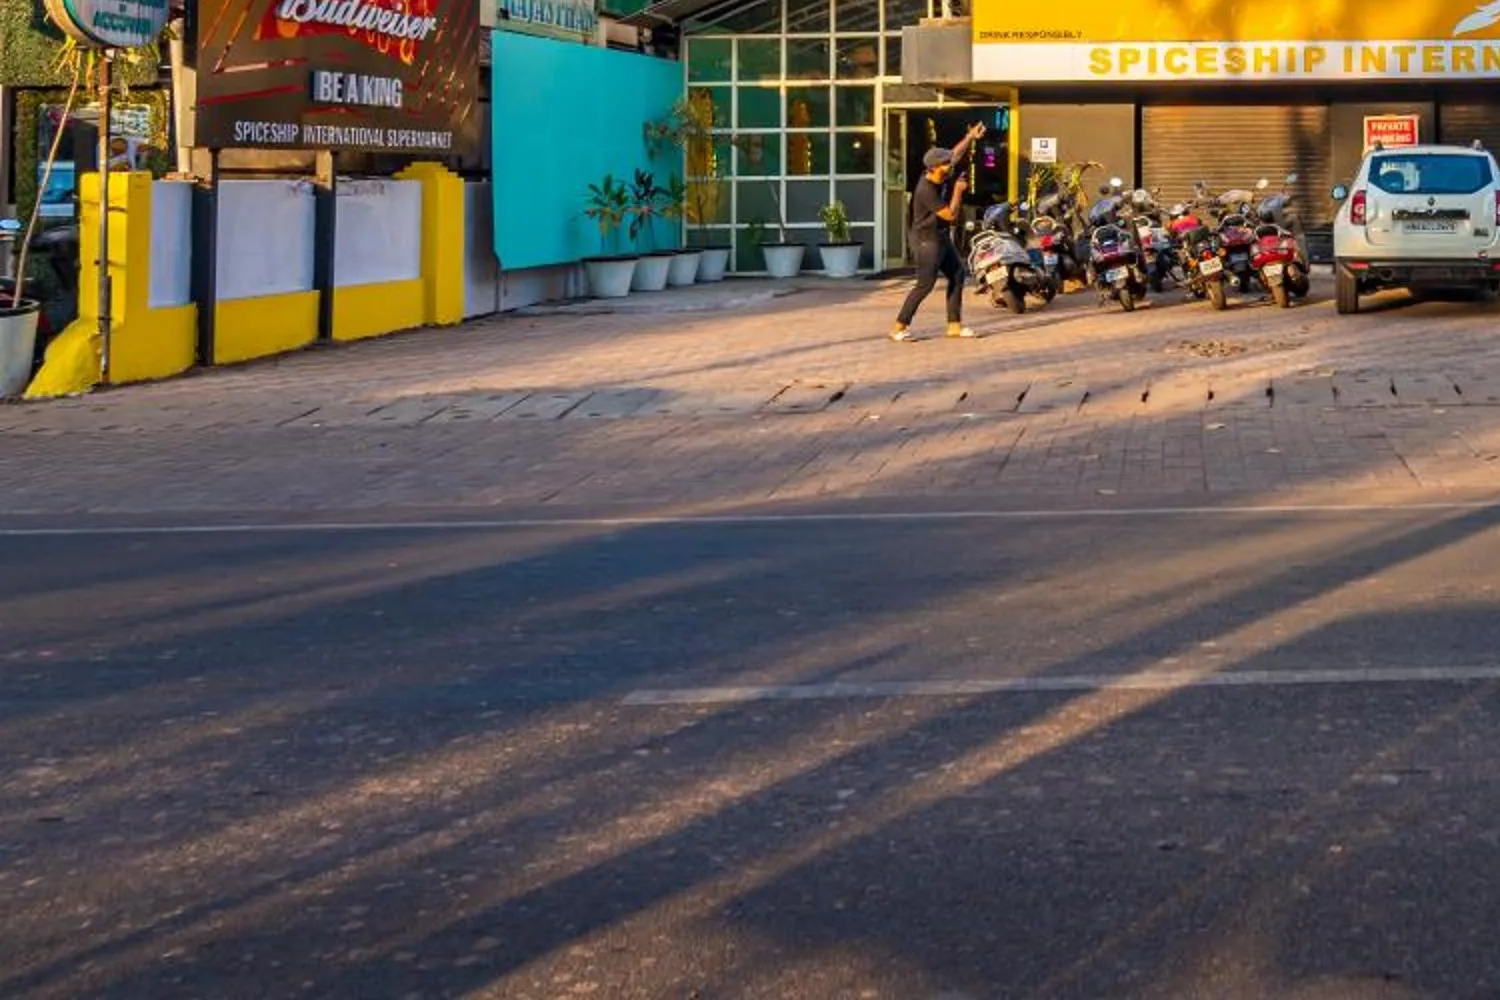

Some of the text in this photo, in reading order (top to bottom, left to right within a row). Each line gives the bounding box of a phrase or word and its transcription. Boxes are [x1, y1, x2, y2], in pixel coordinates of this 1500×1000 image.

[1088, 46, 1326, 75] SPICESHIP
[318, 70, 403, 108] BE A KING
[234, 120, 453, 149] SPICESHIP INTERNATIONAL SUPERMARKET
